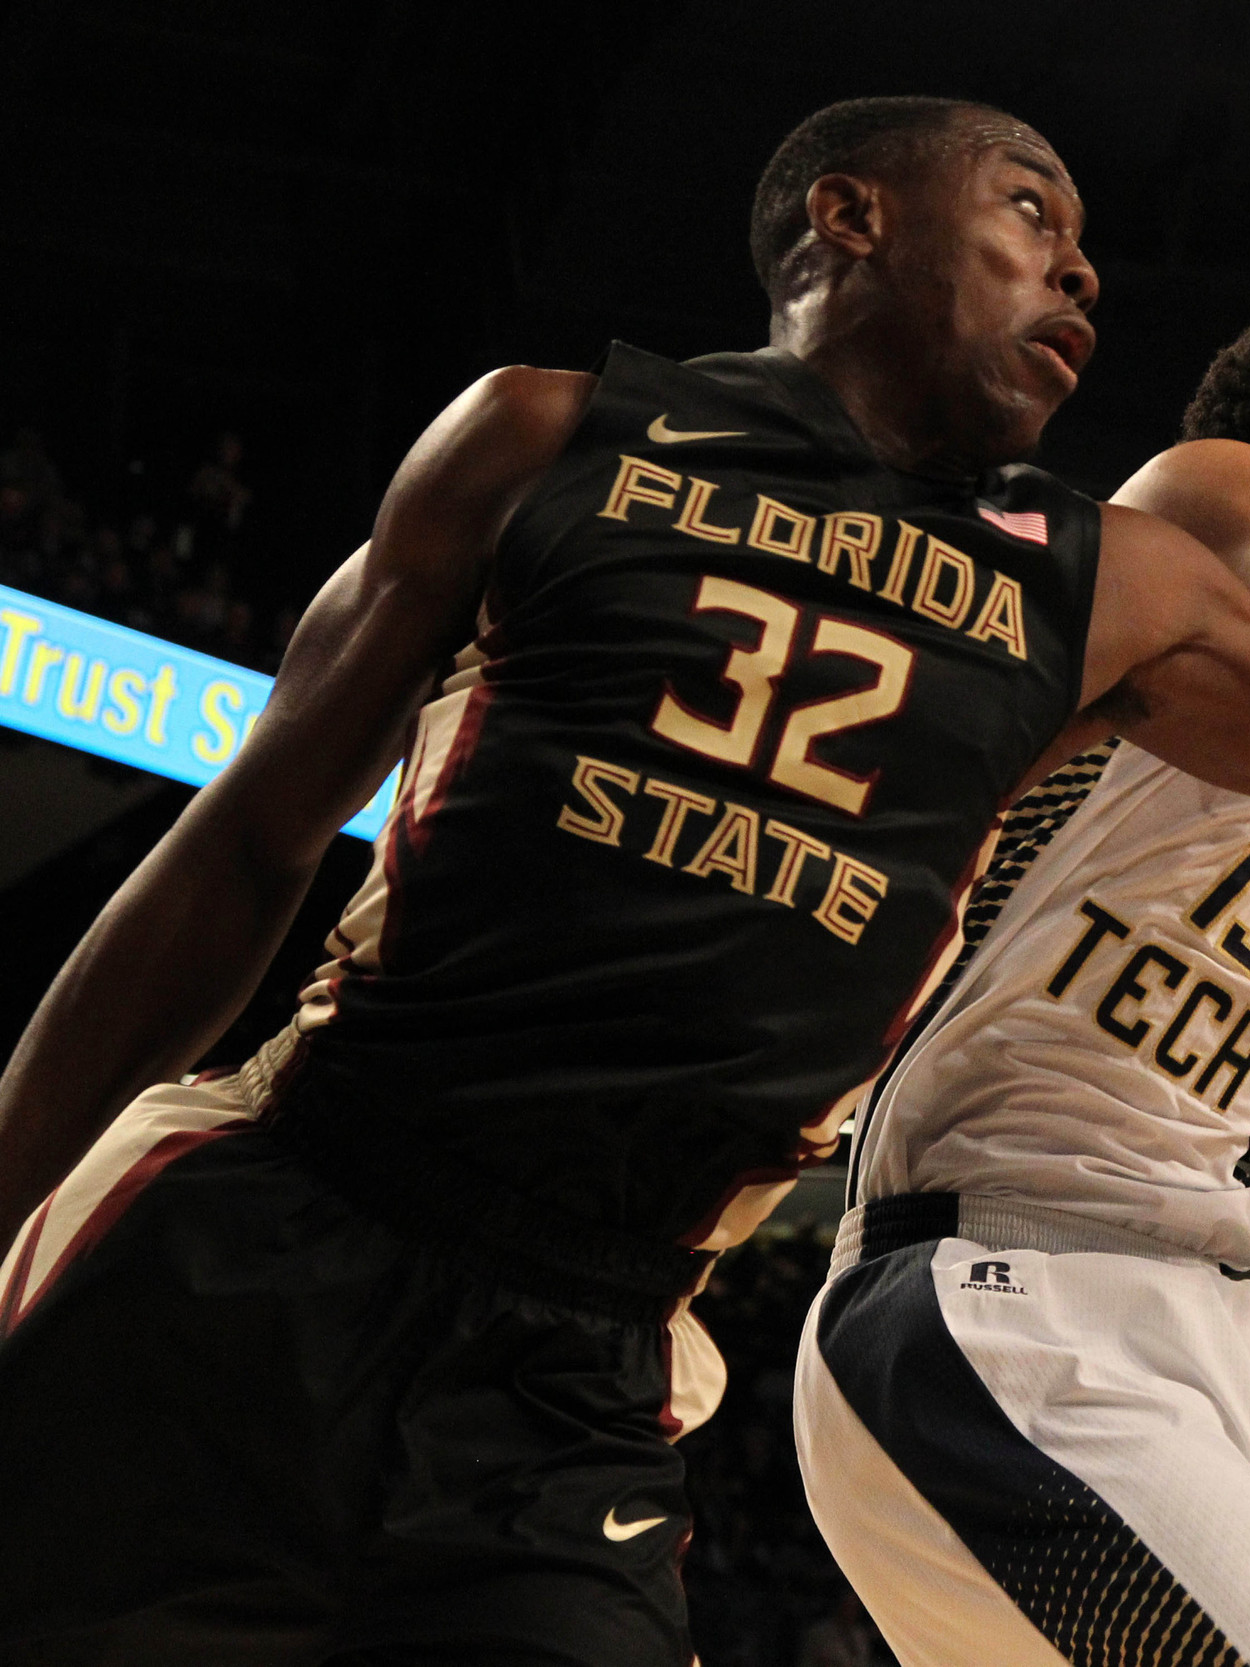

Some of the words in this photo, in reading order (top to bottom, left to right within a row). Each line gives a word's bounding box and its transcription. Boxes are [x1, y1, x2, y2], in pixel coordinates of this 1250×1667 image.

[596, 454, 1028, 661] FLORIDA
[0, 610, 177, 745] Trust
[193, 680, 260, 764] S
[649, 574, 916, 821] 32
[556, 754, 890, 946] STATE
[960, 1282, 1028, 1296] RUSSELL
